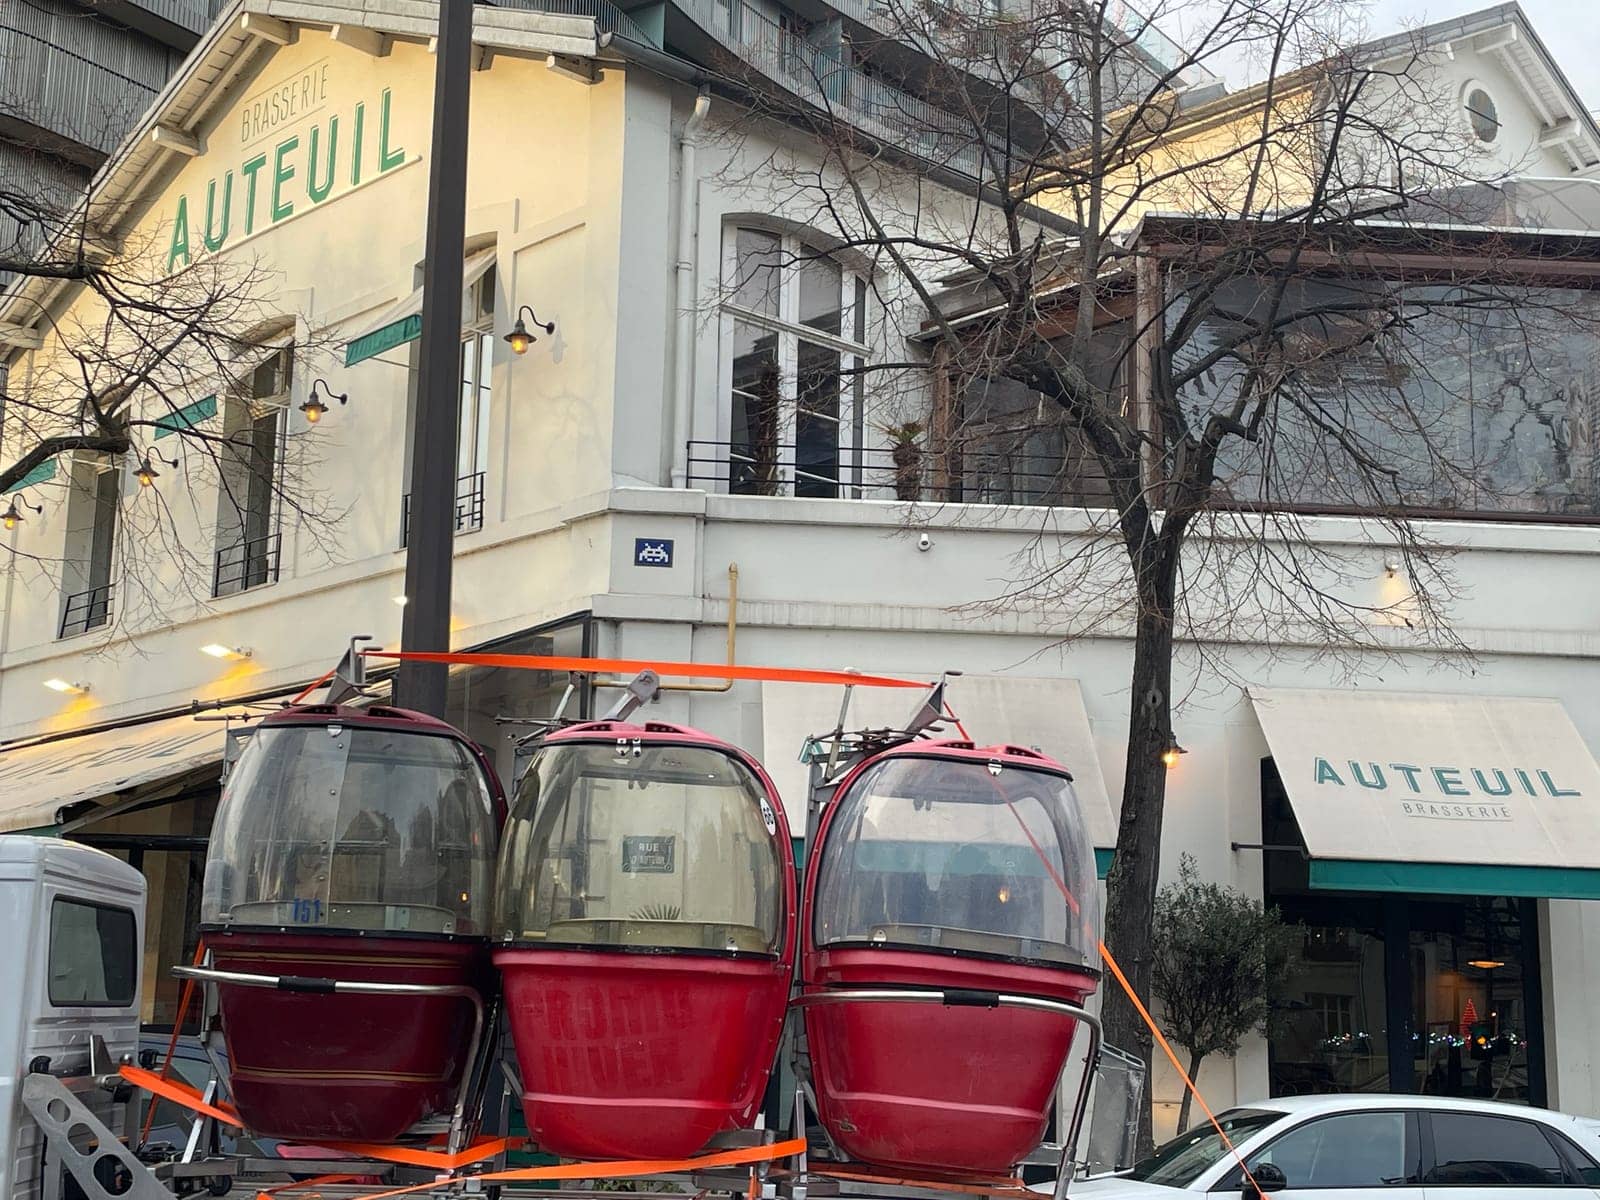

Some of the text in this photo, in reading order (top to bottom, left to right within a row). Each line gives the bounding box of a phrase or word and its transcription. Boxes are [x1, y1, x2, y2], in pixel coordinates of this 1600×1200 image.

[241, 63, 330, 143] BRASSERIE
[166, 87, 407, 274] AUTEUIL
[1313, 756, 1582, 797] AUTEUIL
[1402, 802, 1512, 818] BRASSERIE
[638, 842, 660, 852] RUE
